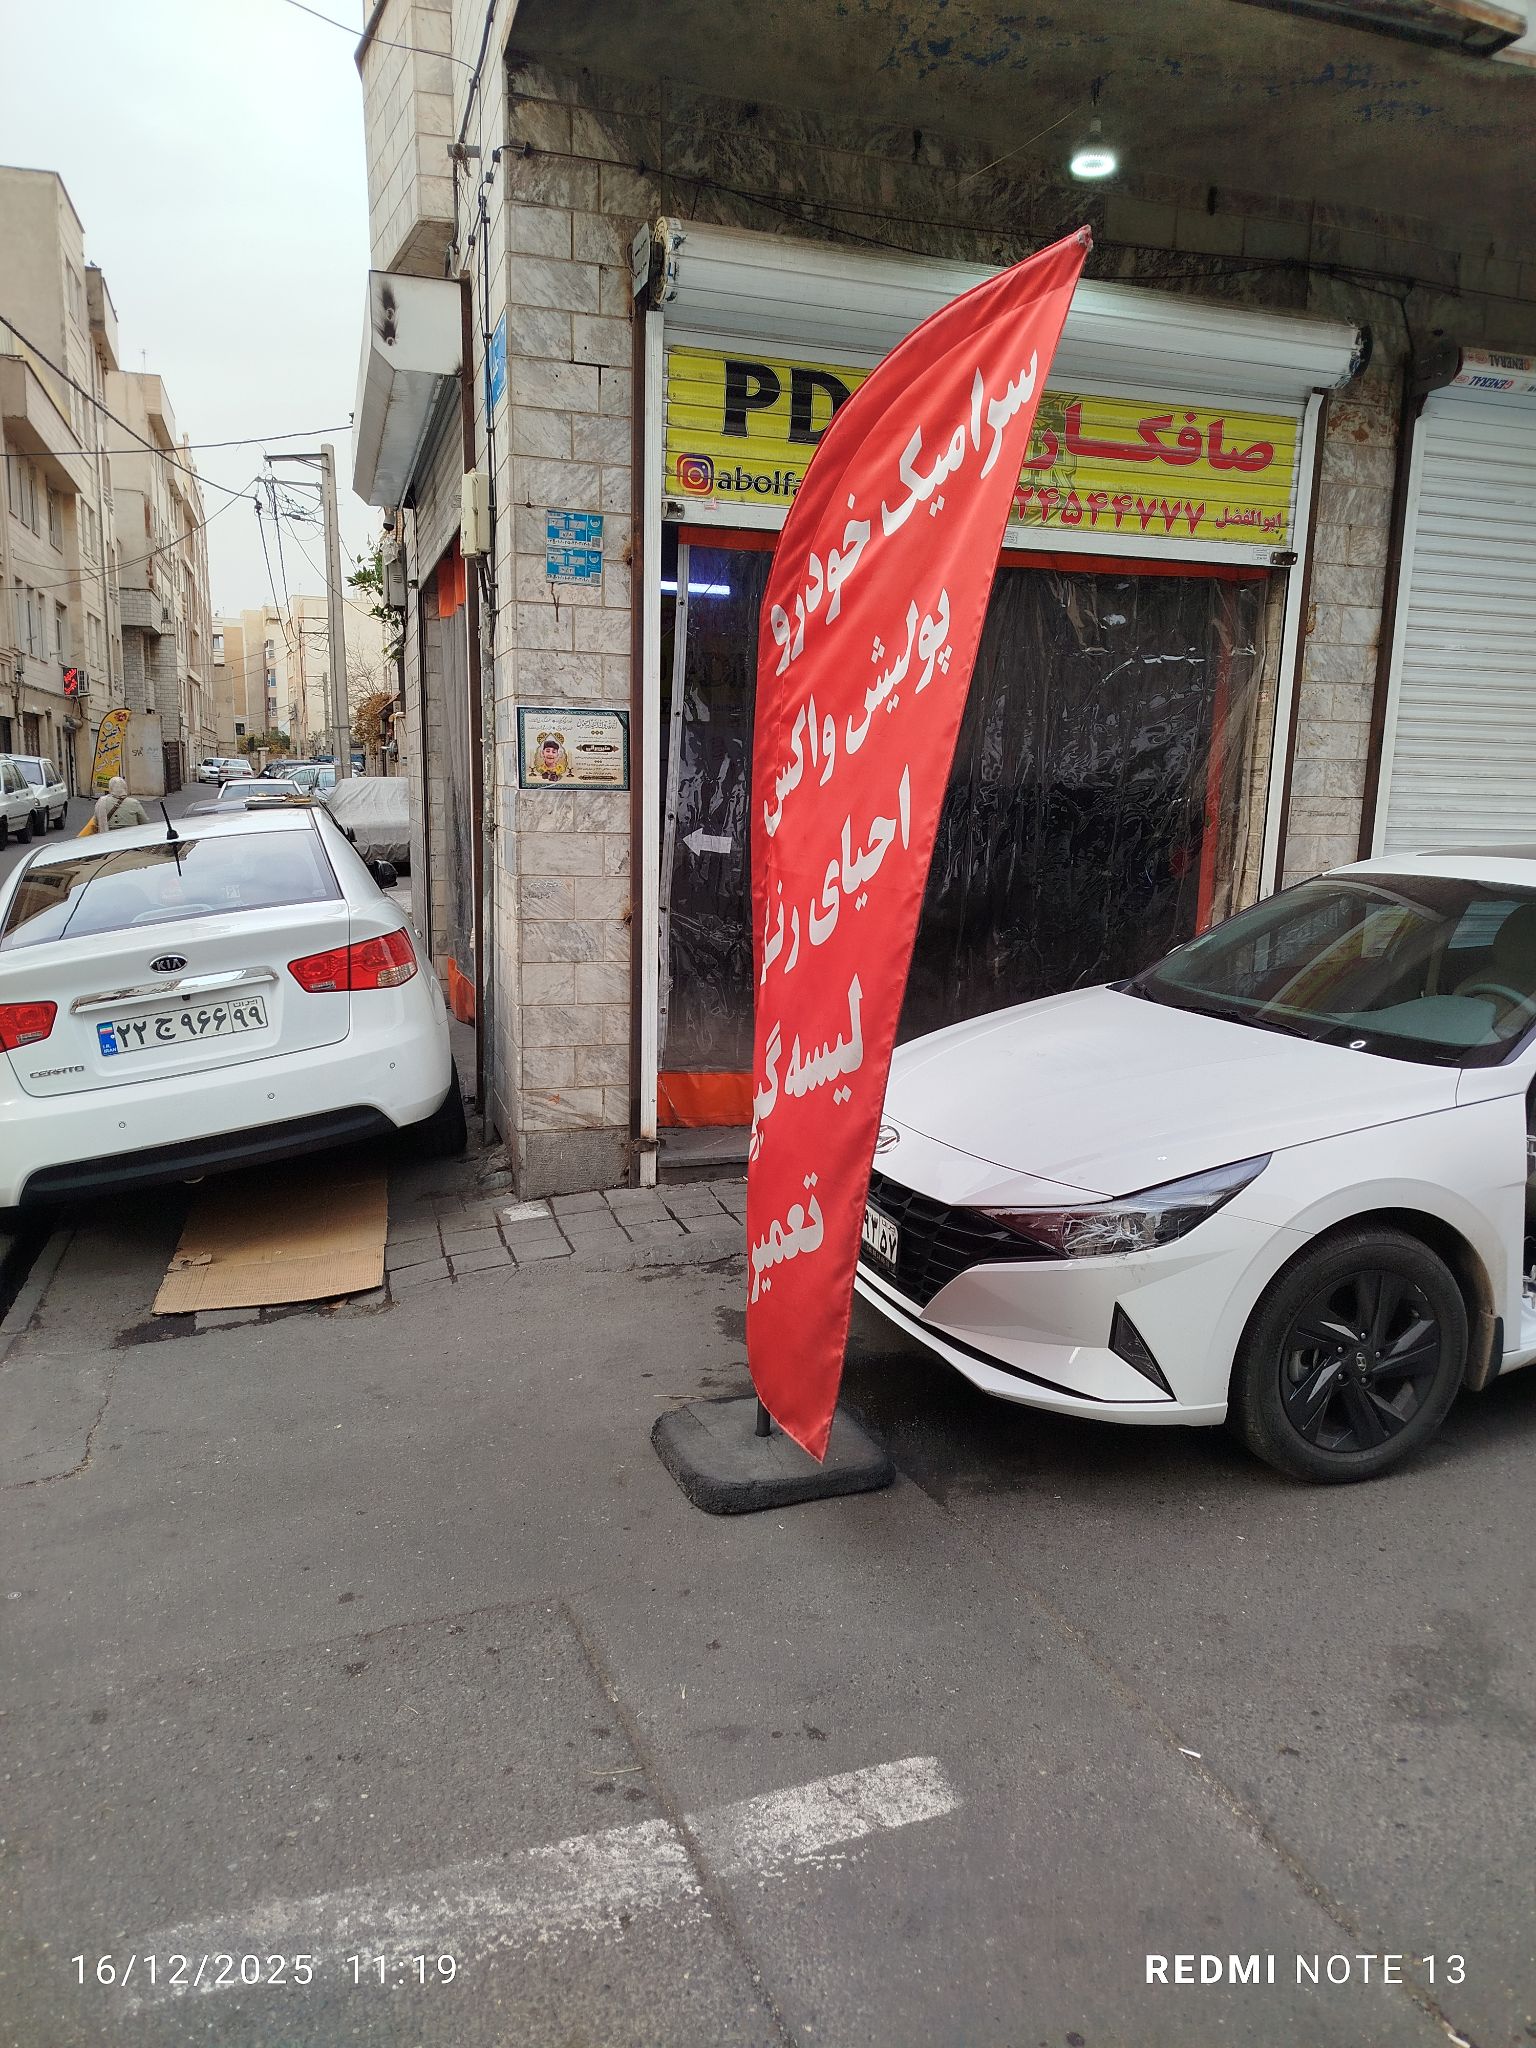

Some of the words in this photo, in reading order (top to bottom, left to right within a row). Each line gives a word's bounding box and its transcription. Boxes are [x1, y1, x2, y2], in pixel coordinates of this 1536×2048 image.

[881, 348, 1037, 537] سرامیک
[770, 494, 871, 677] خودرو
[845, 588, 953, 755] پولیش
[763, 693, 836, 838] واکس
[809, 763, 911, 946] احیای
[156, 957, 182, 971] KIA
[30, 1065, 84, 1079] CERATO
